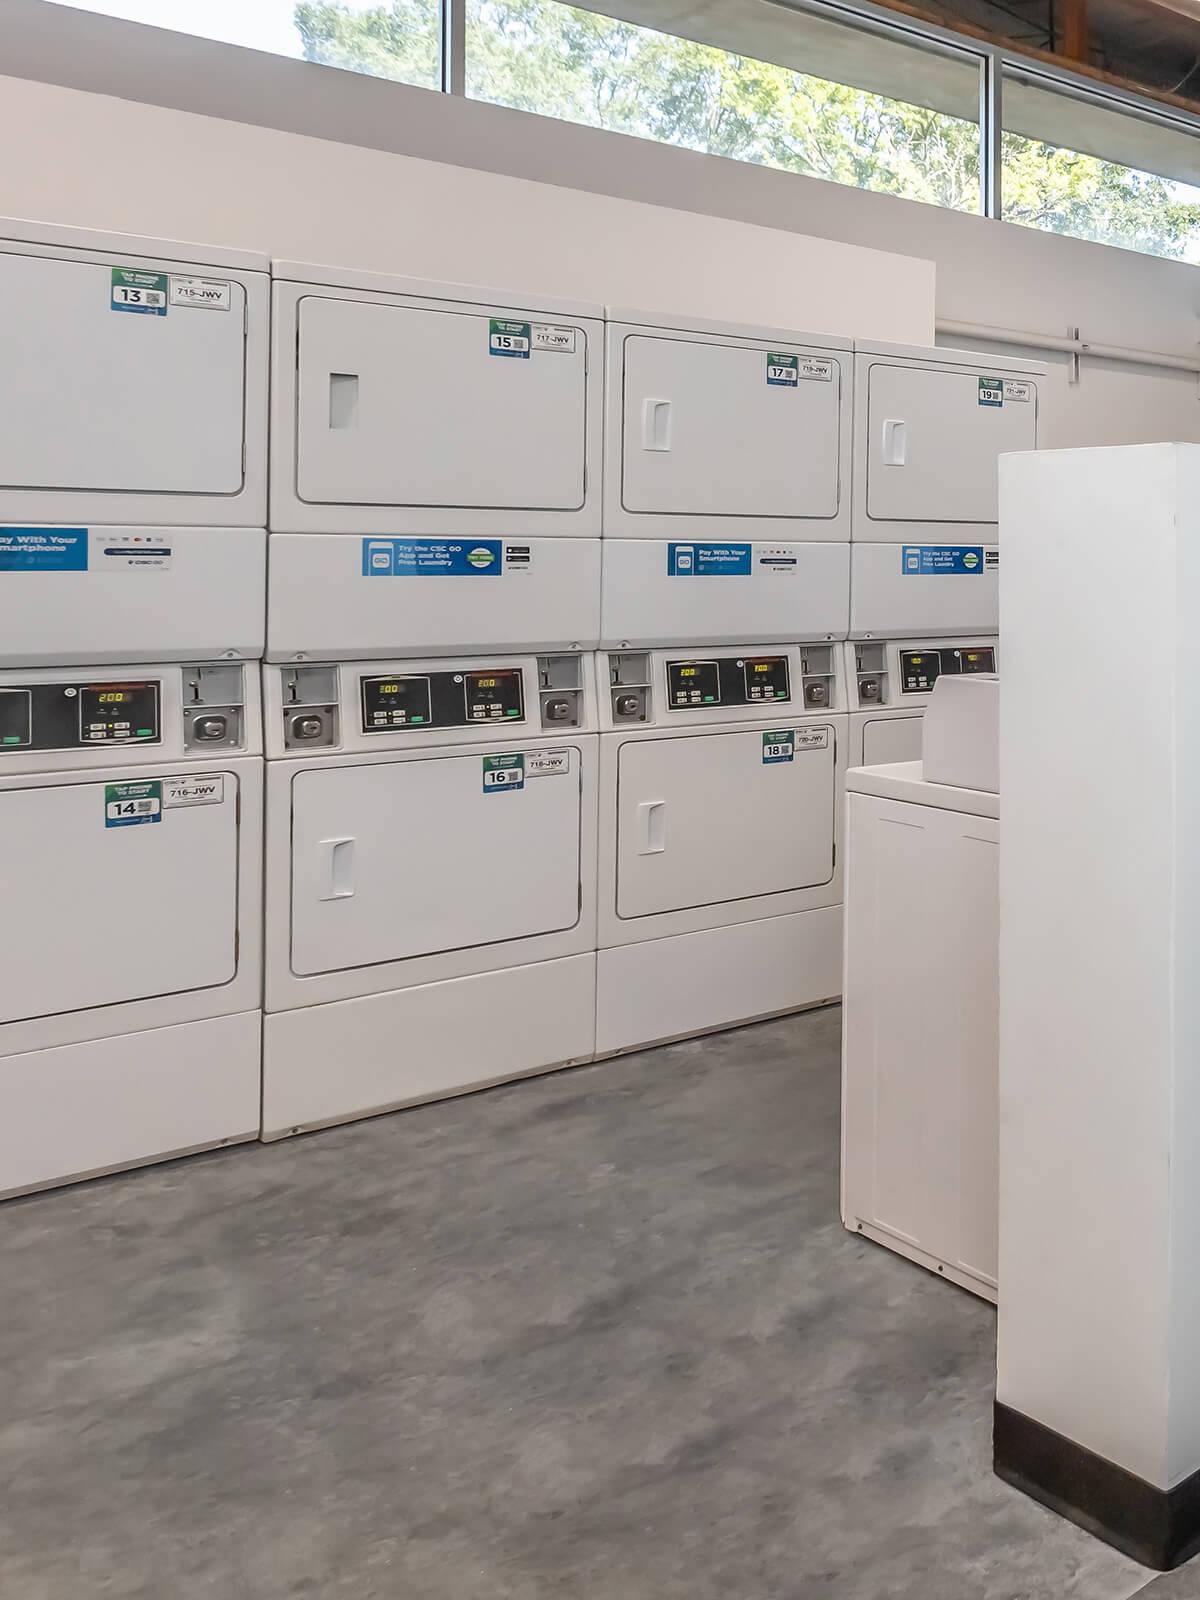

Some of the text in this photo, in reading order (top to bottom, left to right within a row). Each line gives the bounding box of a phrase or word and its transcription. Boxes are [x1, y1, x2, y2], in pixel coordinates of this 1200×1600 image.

[120, 288, 141, 303] 13
[177, 287, 222, 299] 715-JWV
[496, 336, 511, 348] 15
[772, 367, 783, 377] 17
[982, 390, 992, 399] 19
[0, 536, 78, 546] ay With Your
[0, 545, 67, 553] martphone
[400, 545, 412, 553] Try
[419, 559, 453, 567] Laundry
[98, 692, 124, 703] 200
[767, 745, 779, 756] 18
[489, 771, 505, 783] 16
[170, 785, 216, 797] 716-JWV
[114, 802, 136, 816] 14
